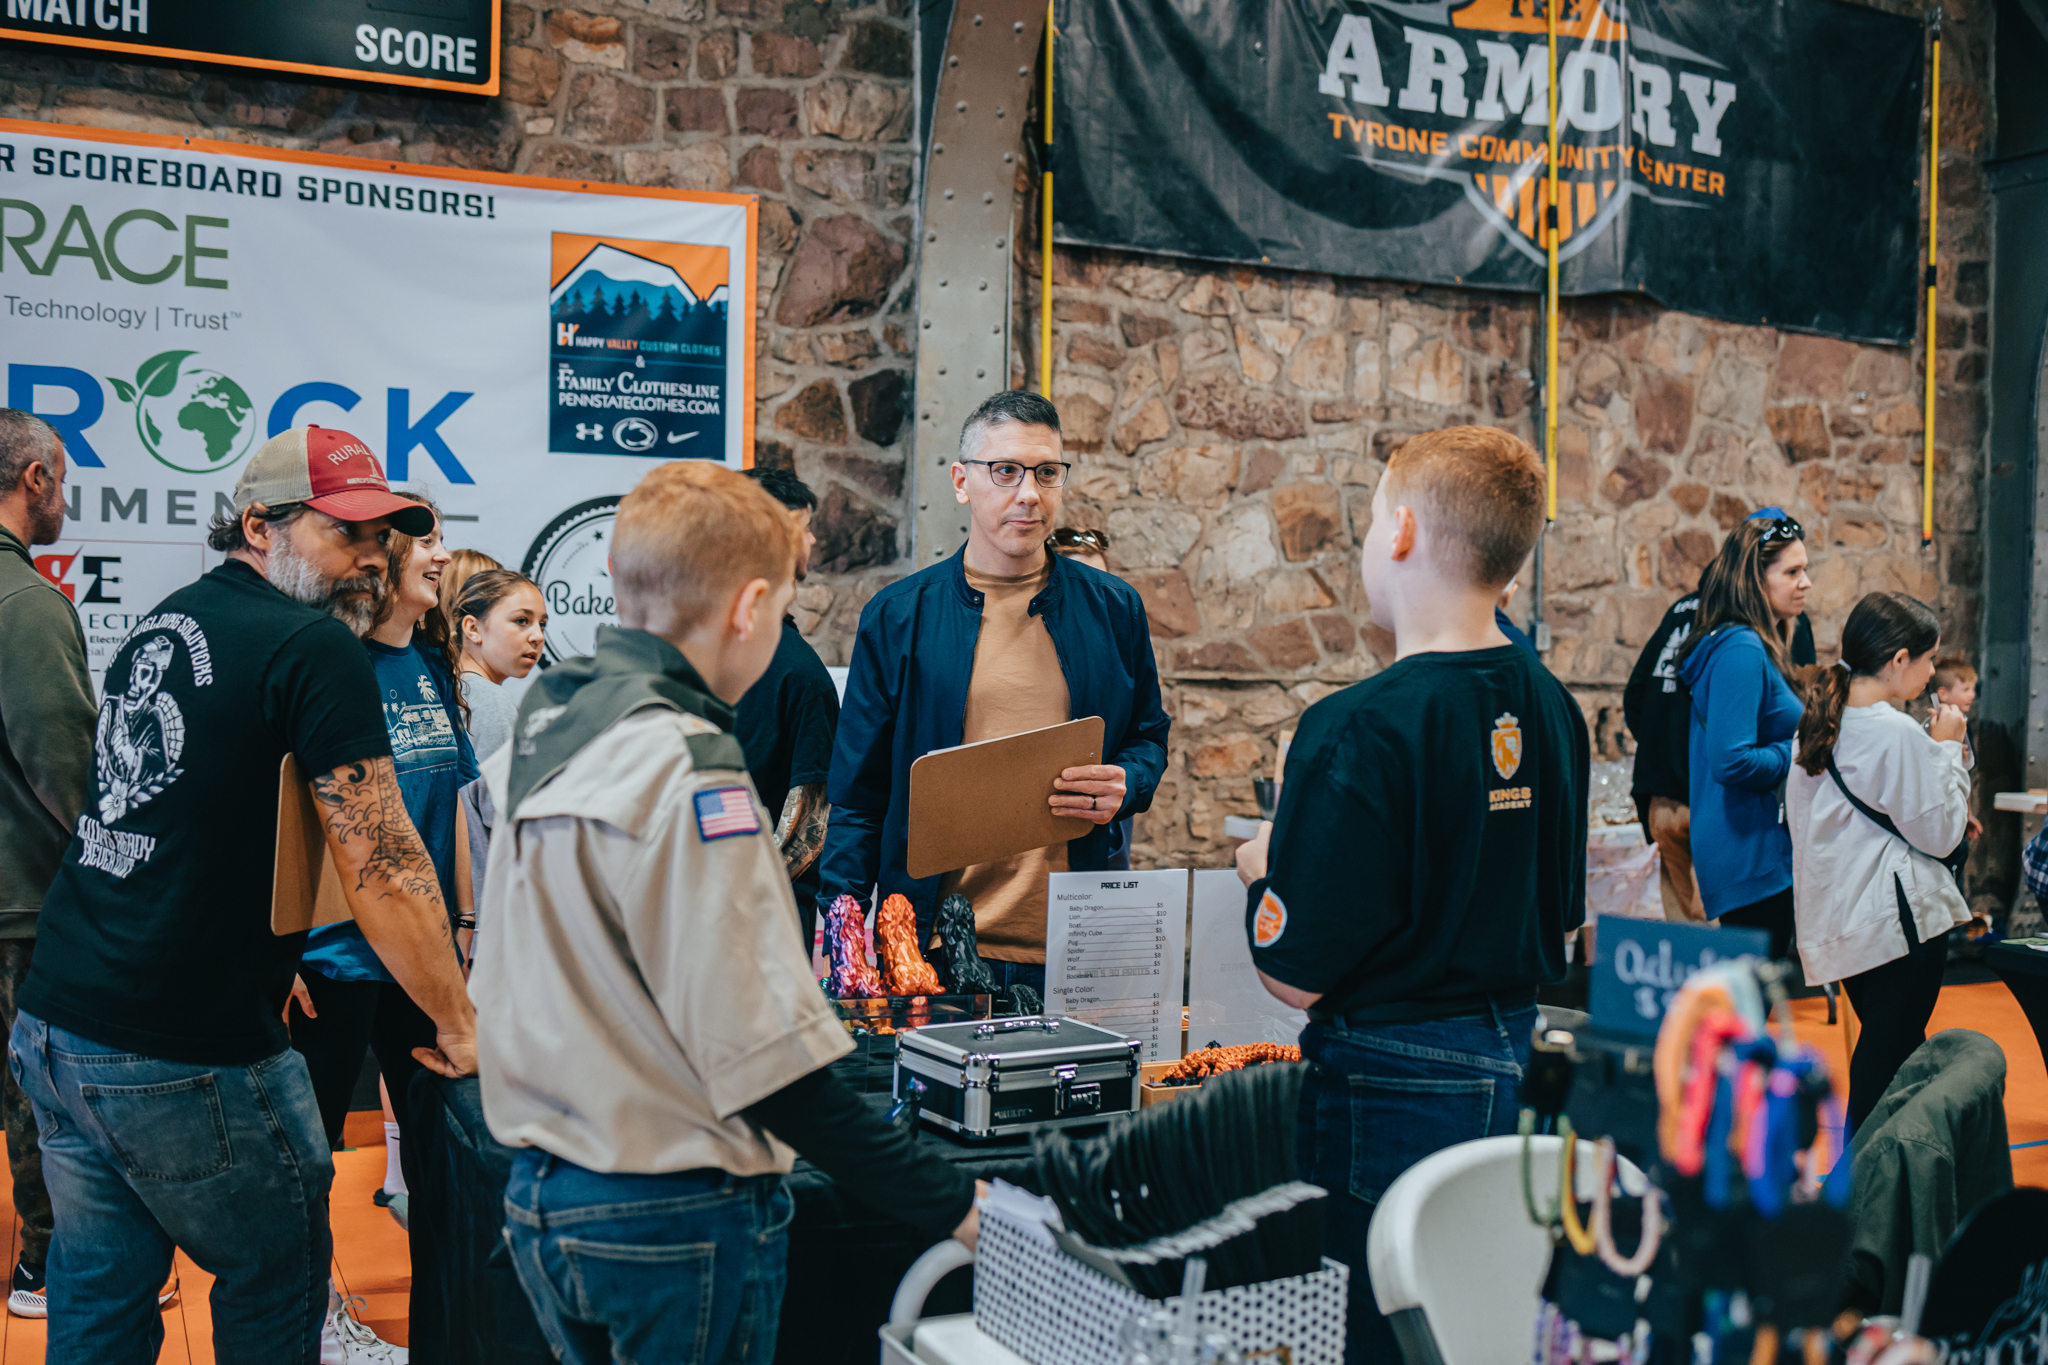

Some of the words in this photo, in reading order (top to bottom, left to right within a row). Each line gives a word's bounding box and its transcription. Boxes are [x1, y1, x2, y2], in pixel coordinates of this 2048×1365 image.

[1509, 0, 1582, 21] TE
[355, 23, 477, 75] SCORE
[1318, 13, 1737, 157] ARMORY
[1327, 112, 1449, 156] TYRONE
[1458, 134, 1635, 171] COMMUNITY
[33, 147, 281, 199] SCOREBOARD
[297, 176, 496, 219] SPONSORS!
[0, 198, 229, 290] RACE
[3, 295, 146, 329] Technology
[576, 336, 605, 349] HAPPY
[606, 338, 639, 350] VALLEY
[639, 340, 679, 353] CUSTOM
[681, 343, 722, 357] CLOTHES
[635, 355, 645, 368] &
[558, 392, 720, 415] PENNSTATECLOTHES.COM
[327, 443, 370, 466] RURAL
[132, 613, 185, 638] WELDING
[177, 616, 213, 687] SOLUTIONS
[1053, 987, 1073, 995] Single
